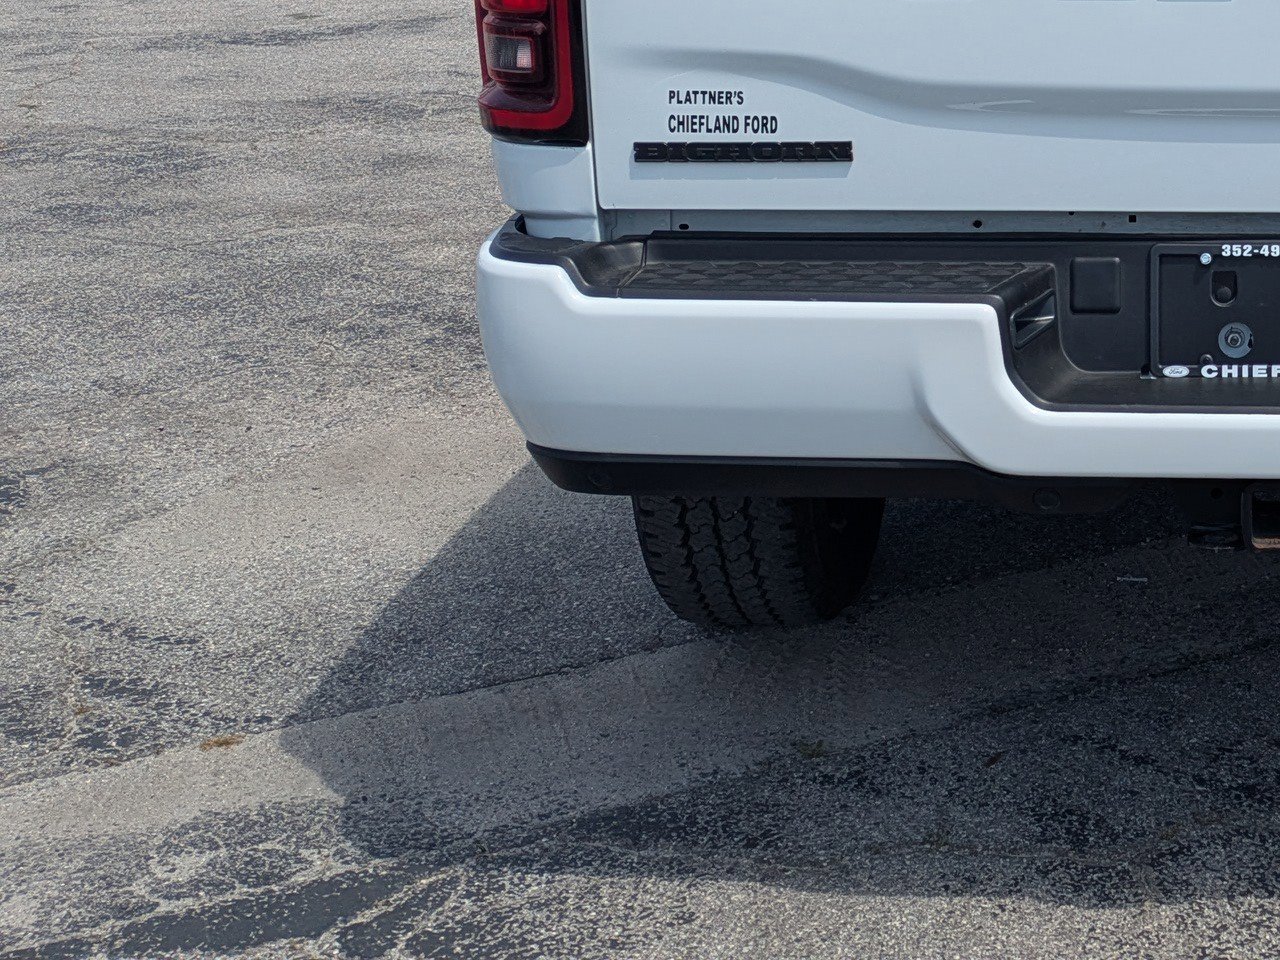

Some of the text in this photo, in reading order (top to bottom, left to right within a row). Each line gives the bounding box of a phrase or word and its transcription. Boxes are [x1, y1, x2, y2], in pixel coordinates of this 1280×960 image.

[668, 90, 744, 106] PLATTNER'S
[668, 114, 778, 134] CHIEFLAND FORD
